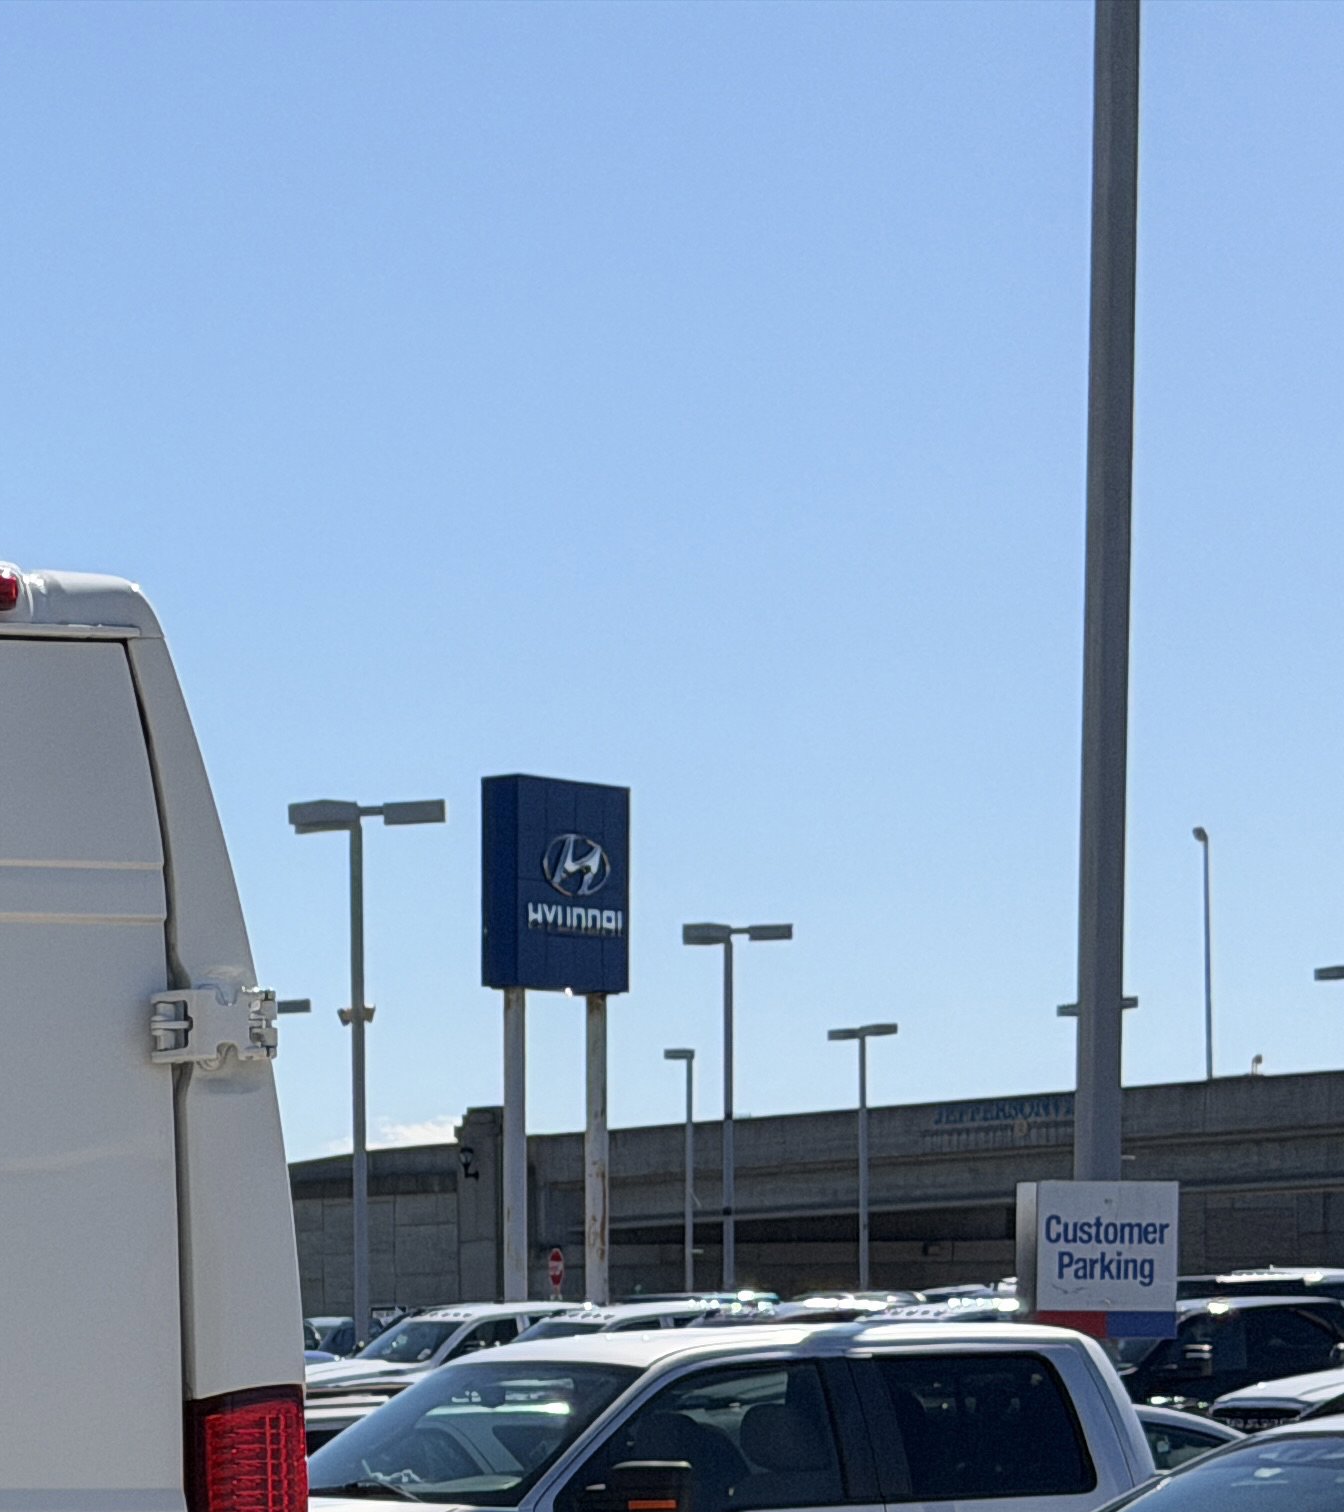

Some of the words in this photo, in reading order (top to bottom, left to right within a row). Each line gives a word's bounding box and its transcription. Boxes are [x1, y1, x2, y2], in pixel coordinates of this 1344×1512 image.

[527, 901, 624, 936] HYUNDAI
[1045, 1214, 1170, 1245] Customer
[1057, 1251, 1155, 1287] Parking
